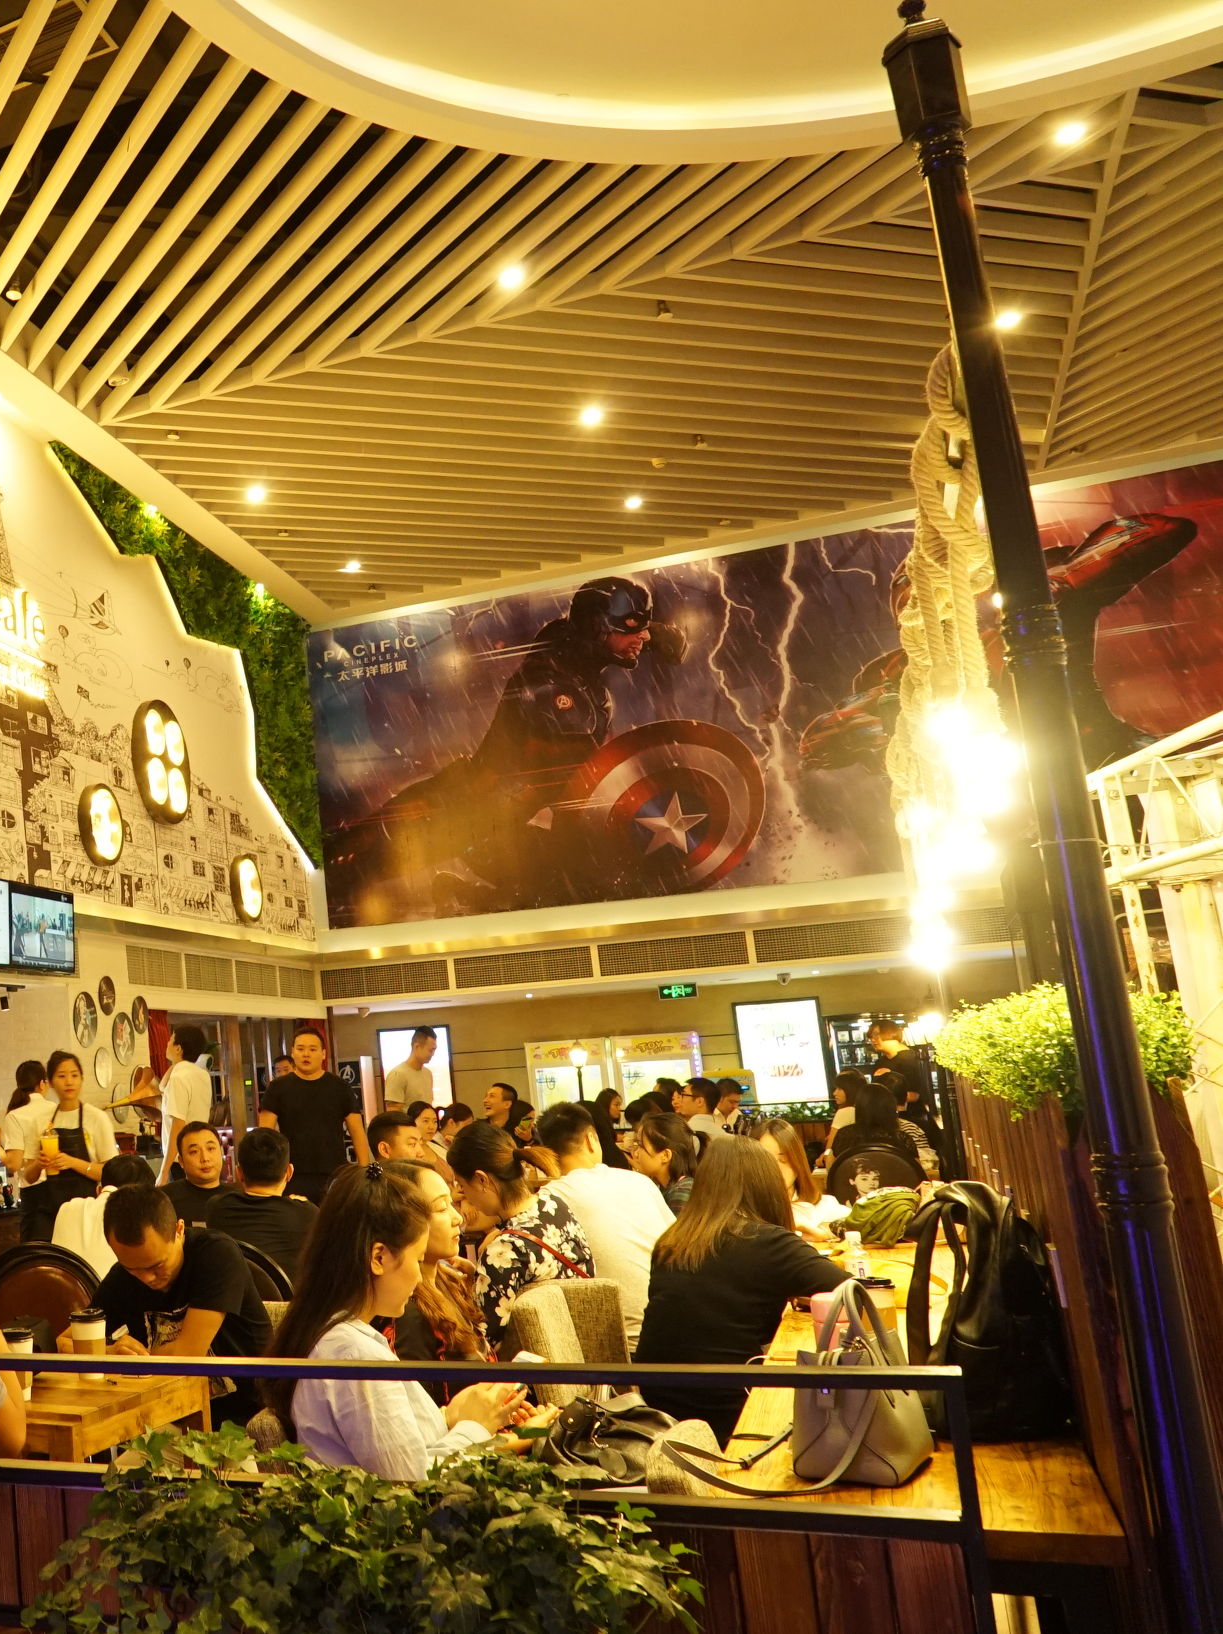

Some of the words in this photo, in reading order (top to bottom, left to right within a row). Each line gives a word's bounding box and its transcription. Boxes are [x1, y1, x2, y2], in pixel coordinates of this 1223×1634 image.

[323, 635, 417, 663] PACIFIC
[343, 652, 400, 667] CINEPLEX
[337, 660, 409, 682] 太平洋影城
